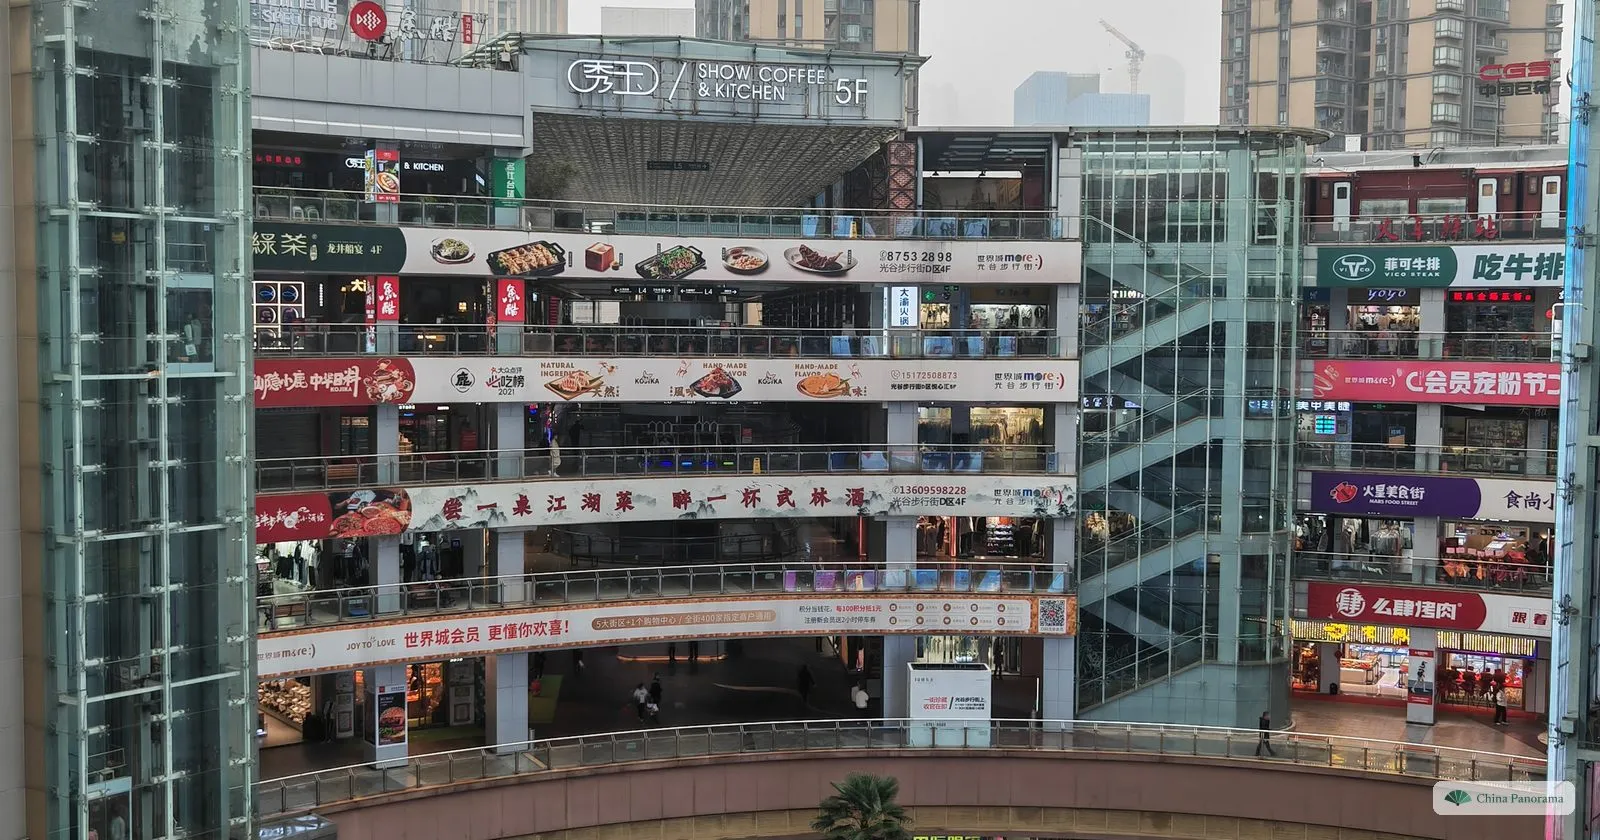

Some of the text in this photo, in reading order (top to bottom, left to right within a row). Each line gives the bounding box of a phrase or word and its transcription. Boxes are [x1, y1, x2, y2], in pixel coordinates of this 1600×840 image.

[699, 63, 825, 85] SHOW COFFEE
[1479, 61, 1551, 80] CGS
[699, 82, 785, 101] & KITCHEN
[835, 79, 868, 104] 5F
[413, 163, 444, 172] KITCHEN
[371, 245, 383, 254] 4F
[887, 252, 952, 262] 8753 2898
[1384, 257, 1440, 271] 菲可牛排
[880, 263, 951, 273] 光谷步行街D区4F
[1473, 252, 1565, 280] 吃牛排
[901, 371, 957, 379] 15172508873
[900, 486, 966, 494] 13609598228
[1363, 483, 1425, 500] 火星美食街
[892, 497, 966, 506] 光谷步行街D区4F
[1372, 597, 1456, 621] 么肆烤肉
[404, 626, 480, 648] 世界城会员
[347, 643, 360, 651] JOY
[377, 638, 396, 647] LOVE
